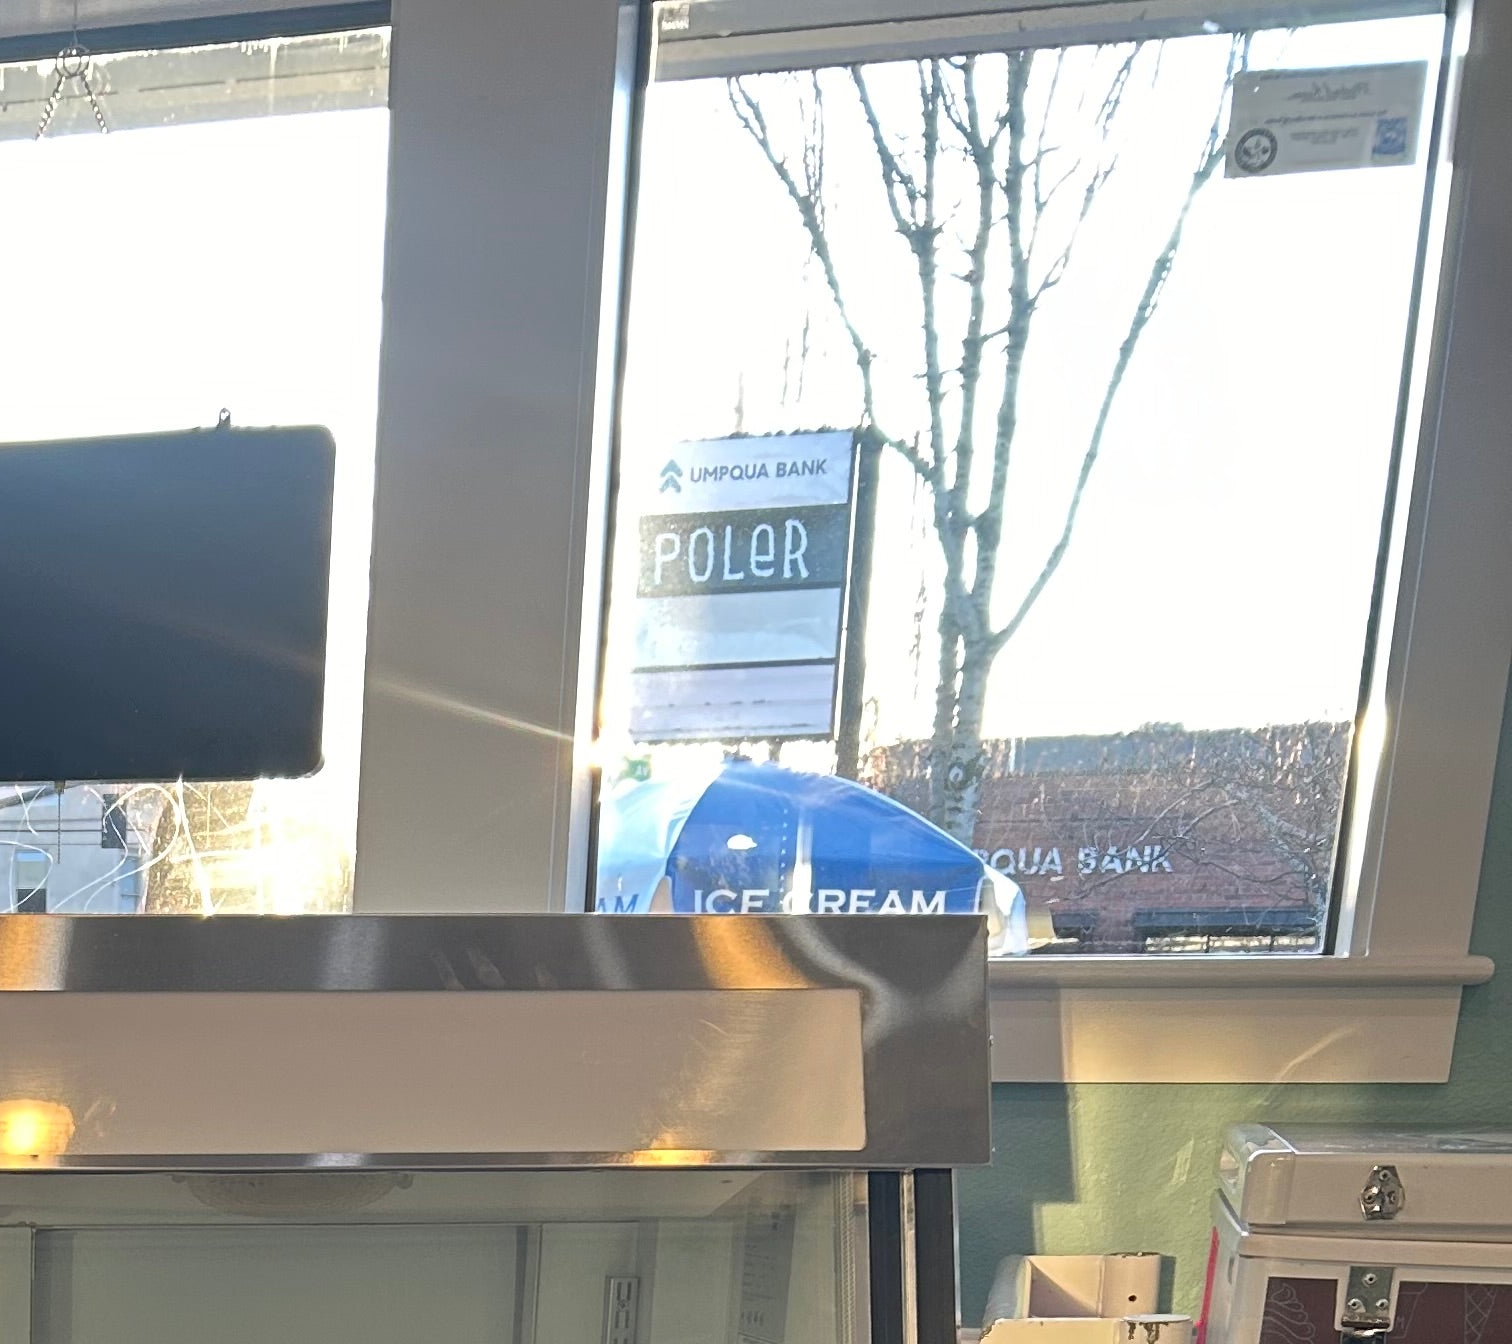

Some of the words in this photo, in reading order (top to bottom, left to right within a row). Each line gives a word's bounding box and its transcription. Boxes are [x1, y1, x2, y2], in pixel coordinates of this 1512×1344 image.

[690, 463, 769, 483] UMPQUA
[775, 458, 828, 478] BANK
[1077, 844, 1175, 874] BANK
[693, 888, 770, 914] ICE
